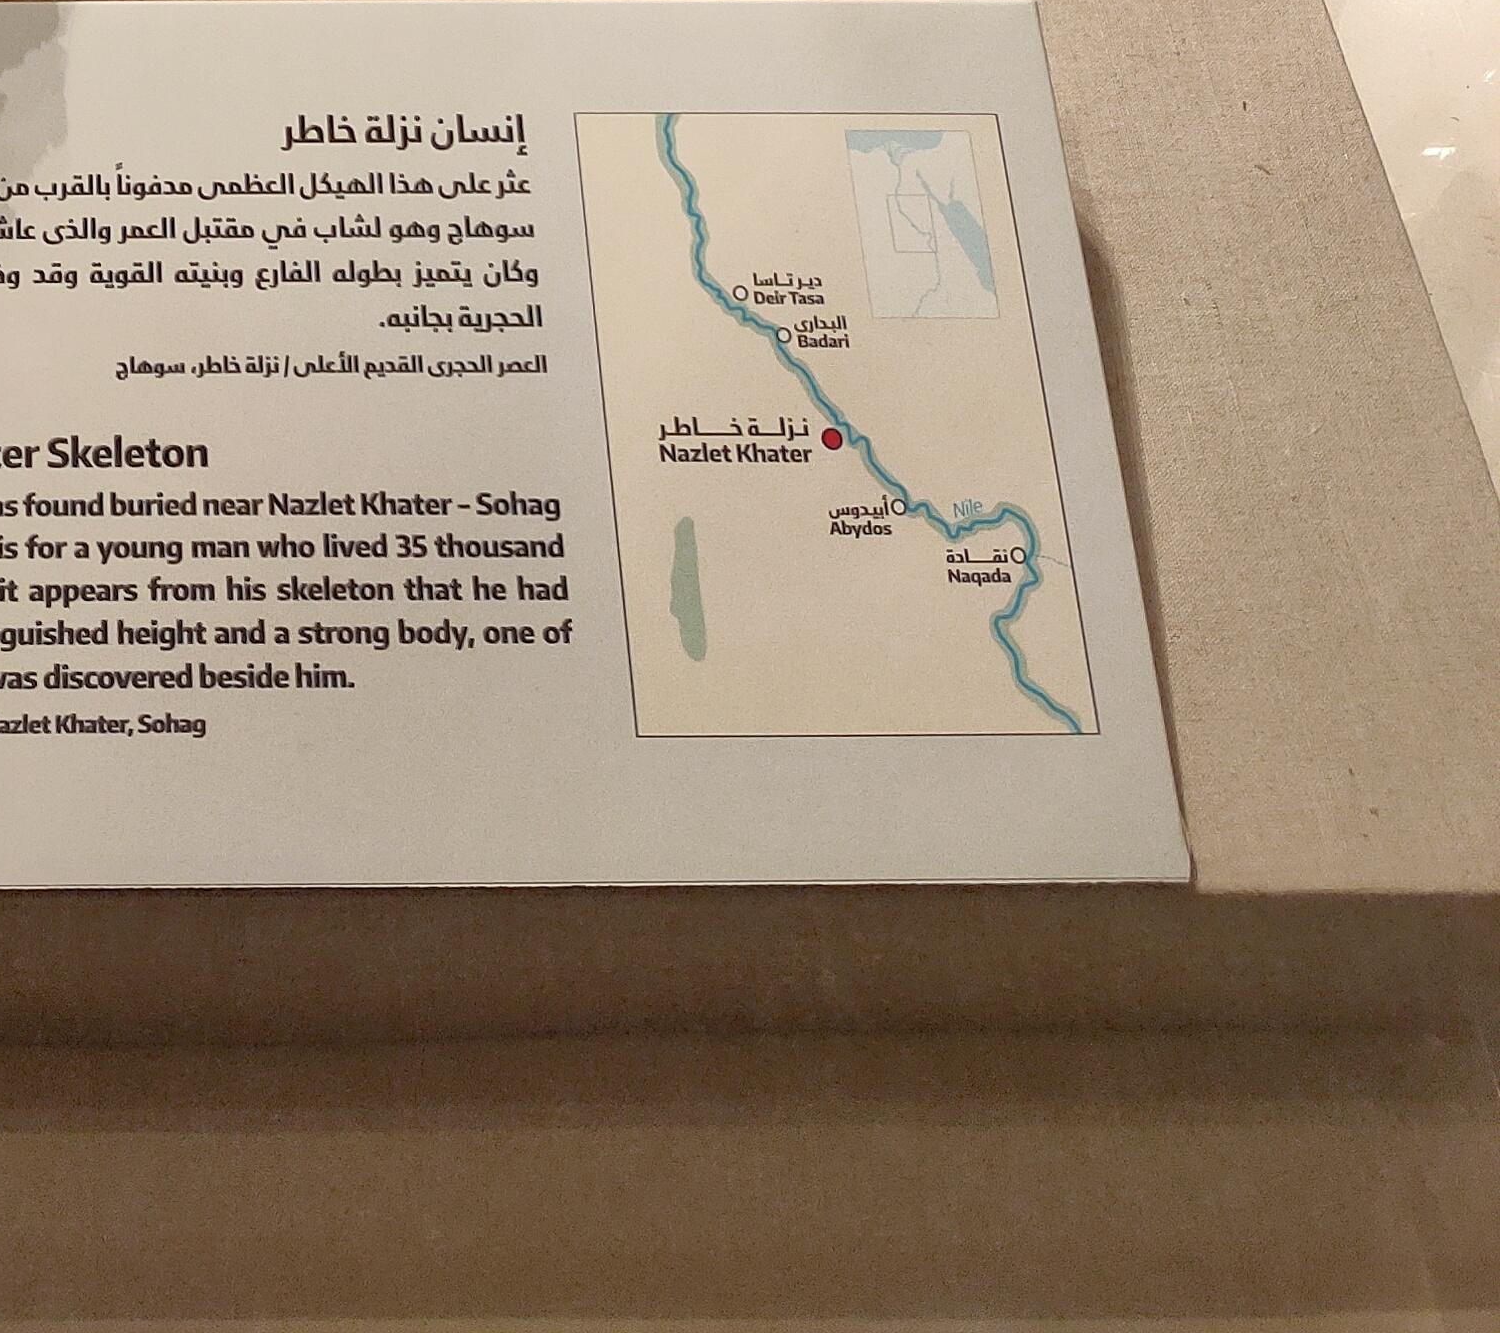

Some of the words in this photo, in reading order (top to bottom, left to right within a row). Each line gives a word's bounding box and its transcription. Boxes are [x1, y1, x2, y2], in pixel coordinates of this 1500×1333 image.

[280, 114, 357, 151] خاطر
[365, 114, 422, 150] نزلة
[431, 114, 528, 156] إنسان
[34, 174, 110, 201] بالقرب
[300, 172, 383, 200] الهيكل
[389, 172, 433, 194] هذا
[495, 169, 531, 199] عثر
[117, 217, 176, 244] العمر
[183, 216, 254, 244] مقتبل
[261, 217, 307, 250] في
[313, 213, 381, 244] لشاب
[389, 221, 440, 243] وهو
[447, 215, 535, 245] سوهاج
[33, 263, 77, 289] وقد
[90, 261, 163, 289] القوية
[174, 262, 243, 288] وبنيته
[255, 260, 321, 290] الفارع
[332, 260, 402, 288] بطوله
[412, 261, 473, 288] يتميز
[483, 259, 539, 288] وكان
[753, 272, 793, 287] تاسا
[797, 276, 822, 291] دير
[754, 290, 787, 305] Deir
[788, 291, 825, 305] Tasa
[379, 304, 453, 333] بجانبه.
[458, 304, 543, 333] الحجرية
[798, 333, 850, 348] Badari
[116, 356, 185, 380] سوهاج
[245, 355, 279, 378] نزلة
[364, 355, 423, 379] القديم
[496, 354, 547, 378] العصر
[658, 416, 743, 441] خاطر
[748, 417, 809, 441] نزلة
[47, 435, 208, 468] Skeleton
[659, 442, 733, 463] Nazlet
[736, 442, 812, 463] Khater
[22, 492, 104, 517] found
[110, 491, 197, 516] buried
[203, 498, 264, 516] near
[268, 491, 356, 516] Nazlet
[360, 491, 453, 516] Khater
[476, 491, 561, 522] Sohag
[829, 495, 889, 519] أبيدوس
[953, 499, 983, 518] Nile
[830, 521, 892, 539] Abydos
[24, 534, 68, 559] for
[74, 541, 89, 559] a
[96, 541, 183, 565] young
[191, 541, 250, 558] man
[256, 533, 315, 558] who
[323, 532, 388, 558] lived
[395, 534, 428, 558] 35
[434, 533, 565, 558] thousand
[946, 548, 1008, 563] نقادة
[948, 568, 1012, 587] Naqada
[29, 584, 138, 609] appears
[147, 576, 215, 601] from
[226, 576, 266, 601] his
[277, 575, 394, 601] skeleton
[403, 576, 463, 601] that
[472, 575, 506, 601] he
[516, 575, 569, 601] had
[117, 619, 207, 651] height
[214, 618, 265, 644] and
[274, 627, 291, 644] a
[298, 622, 390, 650] strong
[398, 618, 475, 650] body,
[483, 626, 535, 644] one
[542, 618, 573, 644] of
[44, 663, 193, 689] discovered
[199, 662, 289, 689] beside
[295, 662, 355, 688] him.
[55, 713, 134, 737] Khater,
[138, 712, 206, 738] Sohag
